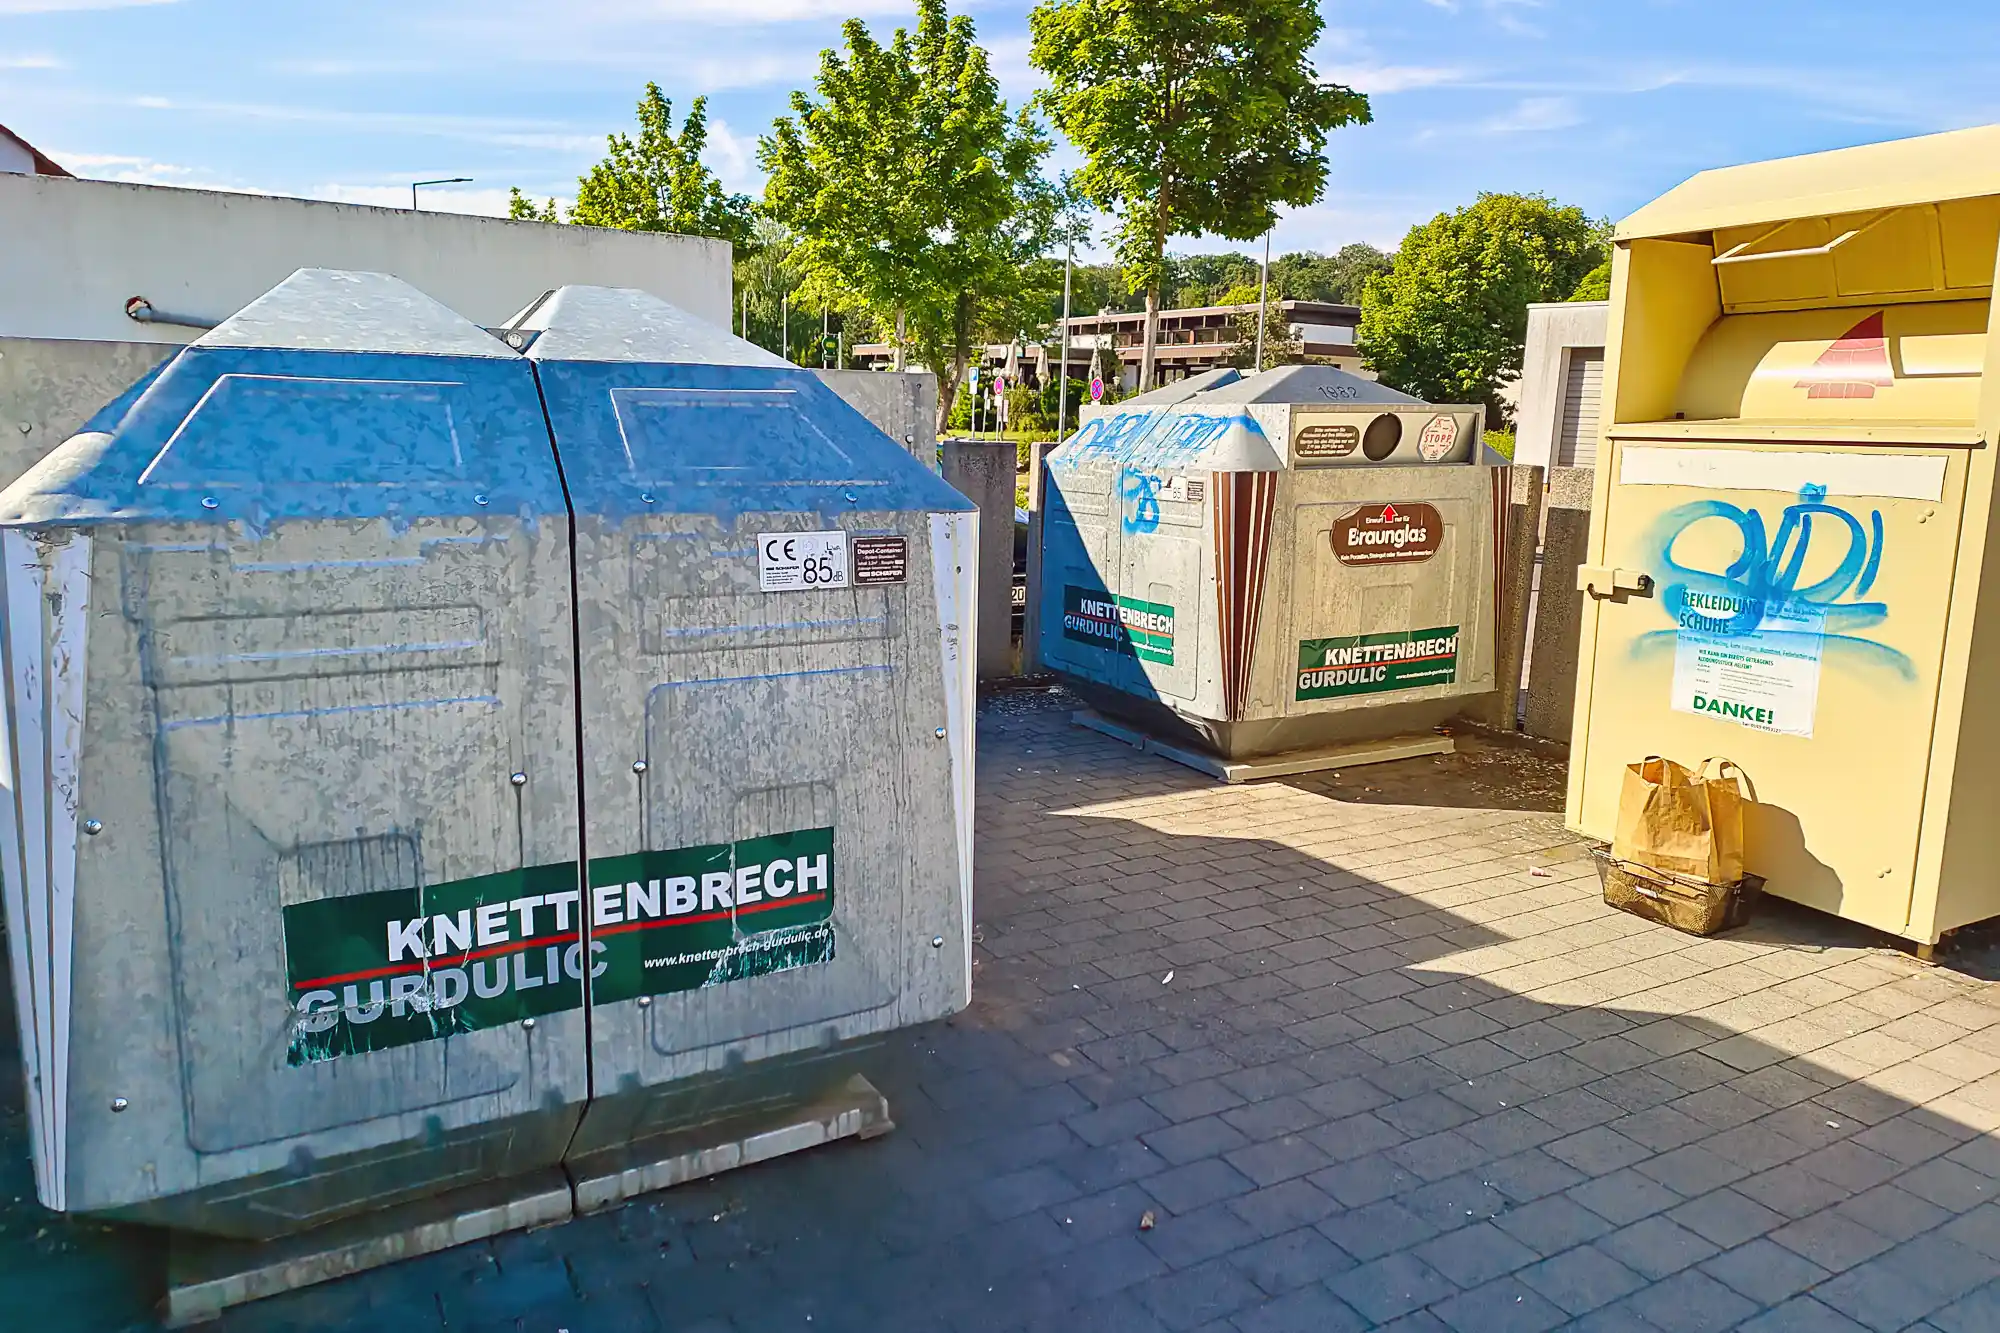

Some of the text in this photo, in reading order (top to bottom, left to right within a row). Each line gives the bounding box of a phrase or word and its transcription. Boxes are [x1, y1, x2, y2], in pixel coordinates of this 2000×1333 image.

[1424, 434, 1452, 443] STOPP
[1348, 524, 1427, 549] Braunglas
[803, 557, 833, 584] 85
[833, 570, 844, 582] dB
[1064, 615, 1123, 642] GURDULIC
[1081, 597, 1174, 634] KNETTENBRECH
[1680, 612, 1731, 635] SCHUHE
[1325, 636, 1456, 666] KNETTENBRECH
[1299, 666, 1387, 690] GURDULIC
[1693, 695, 1774, 725] DANKE!
[387, 853, 828, 963] KNETTENBRECH
[644, 926, 829, 969] www.knettenbrech-gurdulic.de
[296, 940, 608, 1034] GURDULIC
